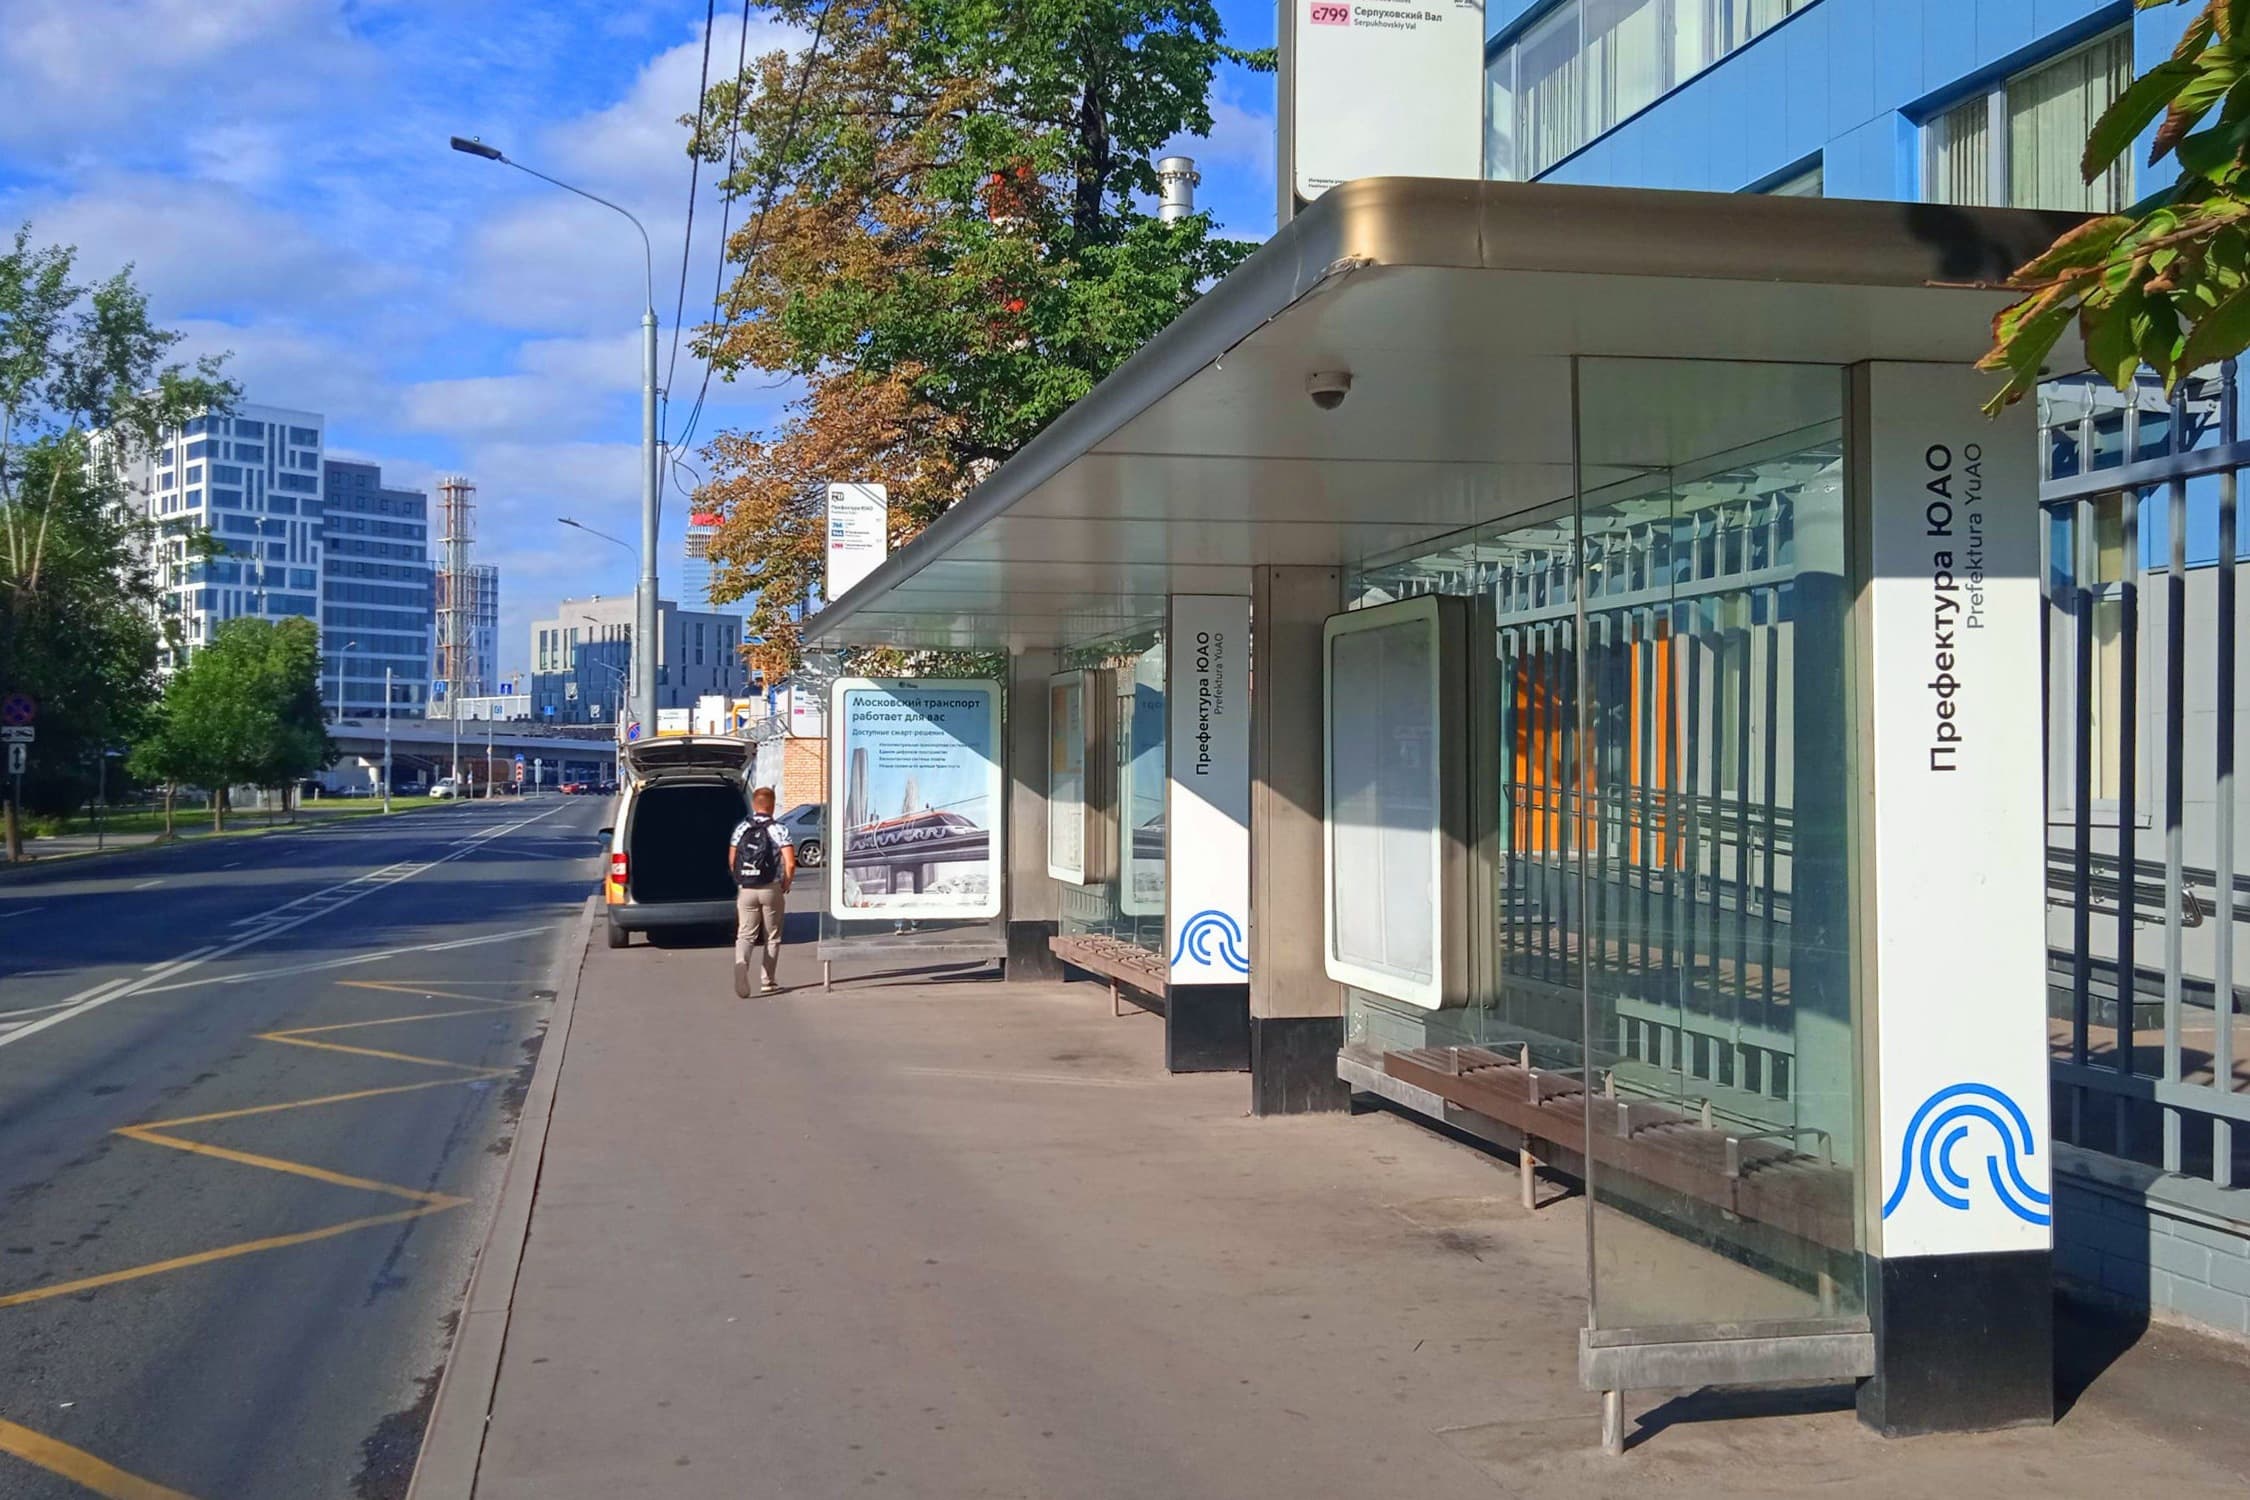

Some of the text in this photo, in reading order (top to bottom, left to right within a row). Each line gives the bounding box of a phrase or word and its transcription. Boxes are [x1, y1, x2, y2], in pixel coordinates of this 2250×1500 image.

[1354, 6, 1423, 20] Серпуховский
[1424, 12, 1443, 22] Вал
[1354, 18, 1417, 30] Serpukhovskiy Val
[1964, 443, 1985, 629] Prefektura YuAO
[1925, 443, 1962, 772] Префектура ЮАО
[1214, 633, 1224, 715] Prefektura YuAO
[852, 696, 980, 710] Московский транспорт
[852, 711, 945, 722] работает для вас
[1196, 631, 1212, 775] Префектура ЮАО
